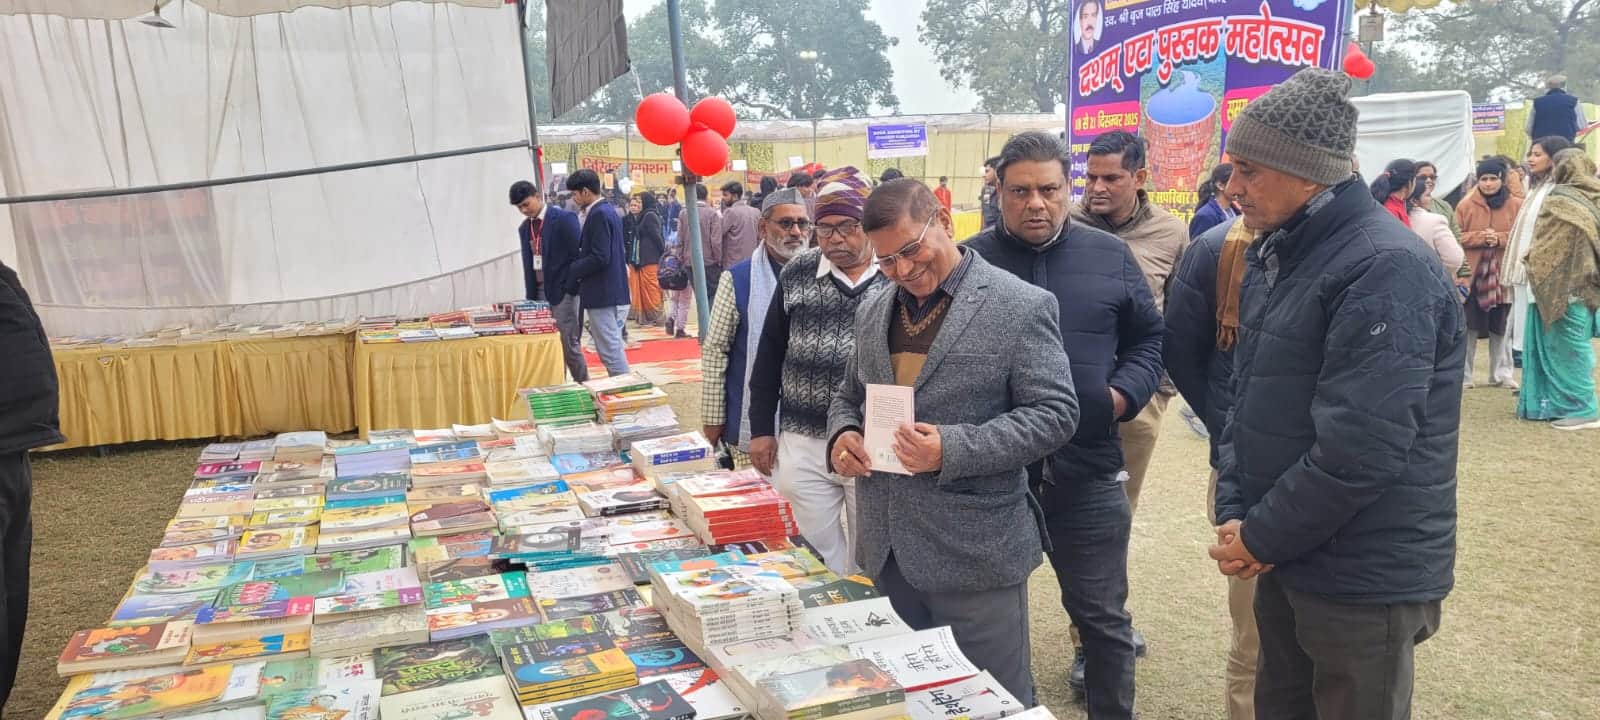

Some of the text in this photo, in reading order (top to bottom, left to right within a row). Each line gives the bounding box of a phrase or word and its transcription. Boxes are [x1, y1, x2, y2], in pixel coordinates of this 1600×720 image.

[1079, 1, 1324, 95] दशम् एटा पुस्तक महोत्सव
